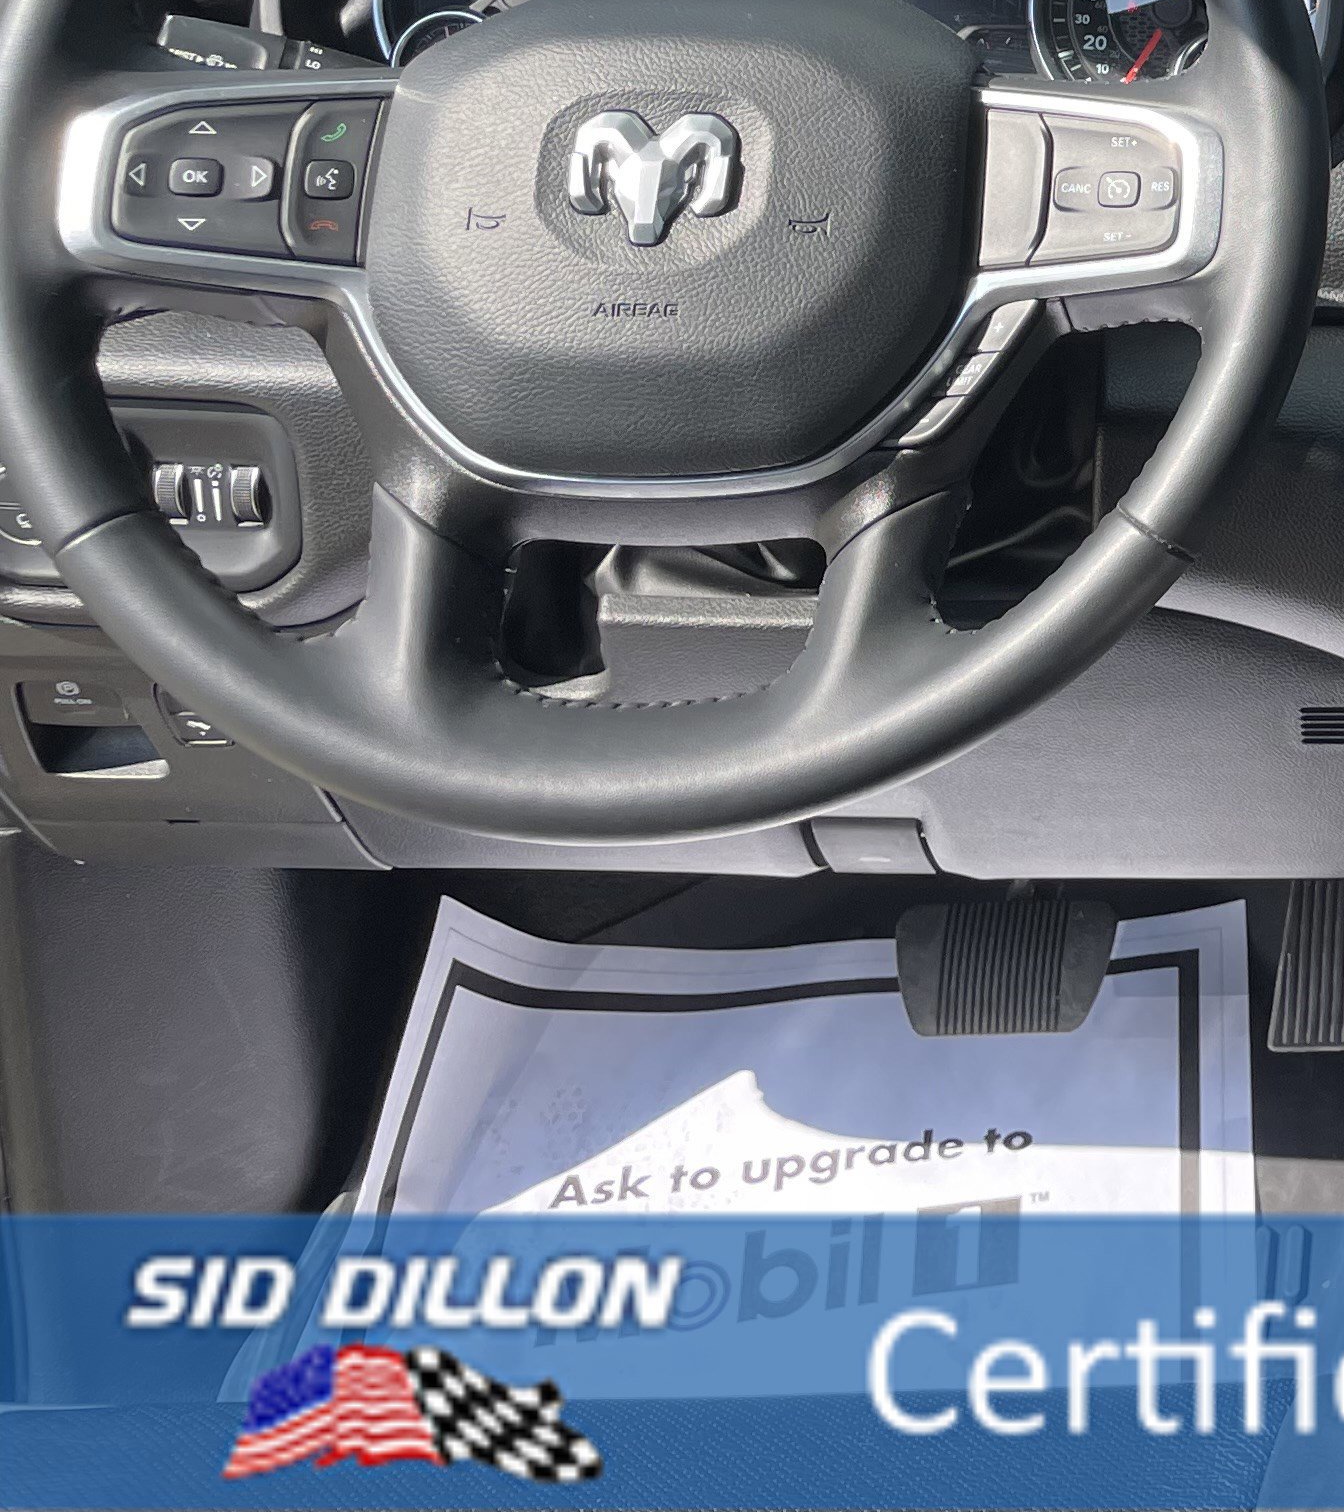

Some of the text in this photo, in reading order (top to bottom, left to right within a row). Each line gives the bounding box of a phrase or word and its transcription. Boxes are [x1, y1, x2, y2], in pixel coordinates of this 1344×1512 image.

[1074, 13, 1090, 25] 30
[1083, 34, 1107, 50] 20
[304, 59, 322, 70] LO
[1095, 62, 1110, 74] 10
[182, 169, 209, 184] OK
[1061, 182, 1092, 194] CANC
[1150, 181, 1170, 192] RES
[548, 1126, 1034, 1210] Ask to upgrade to
